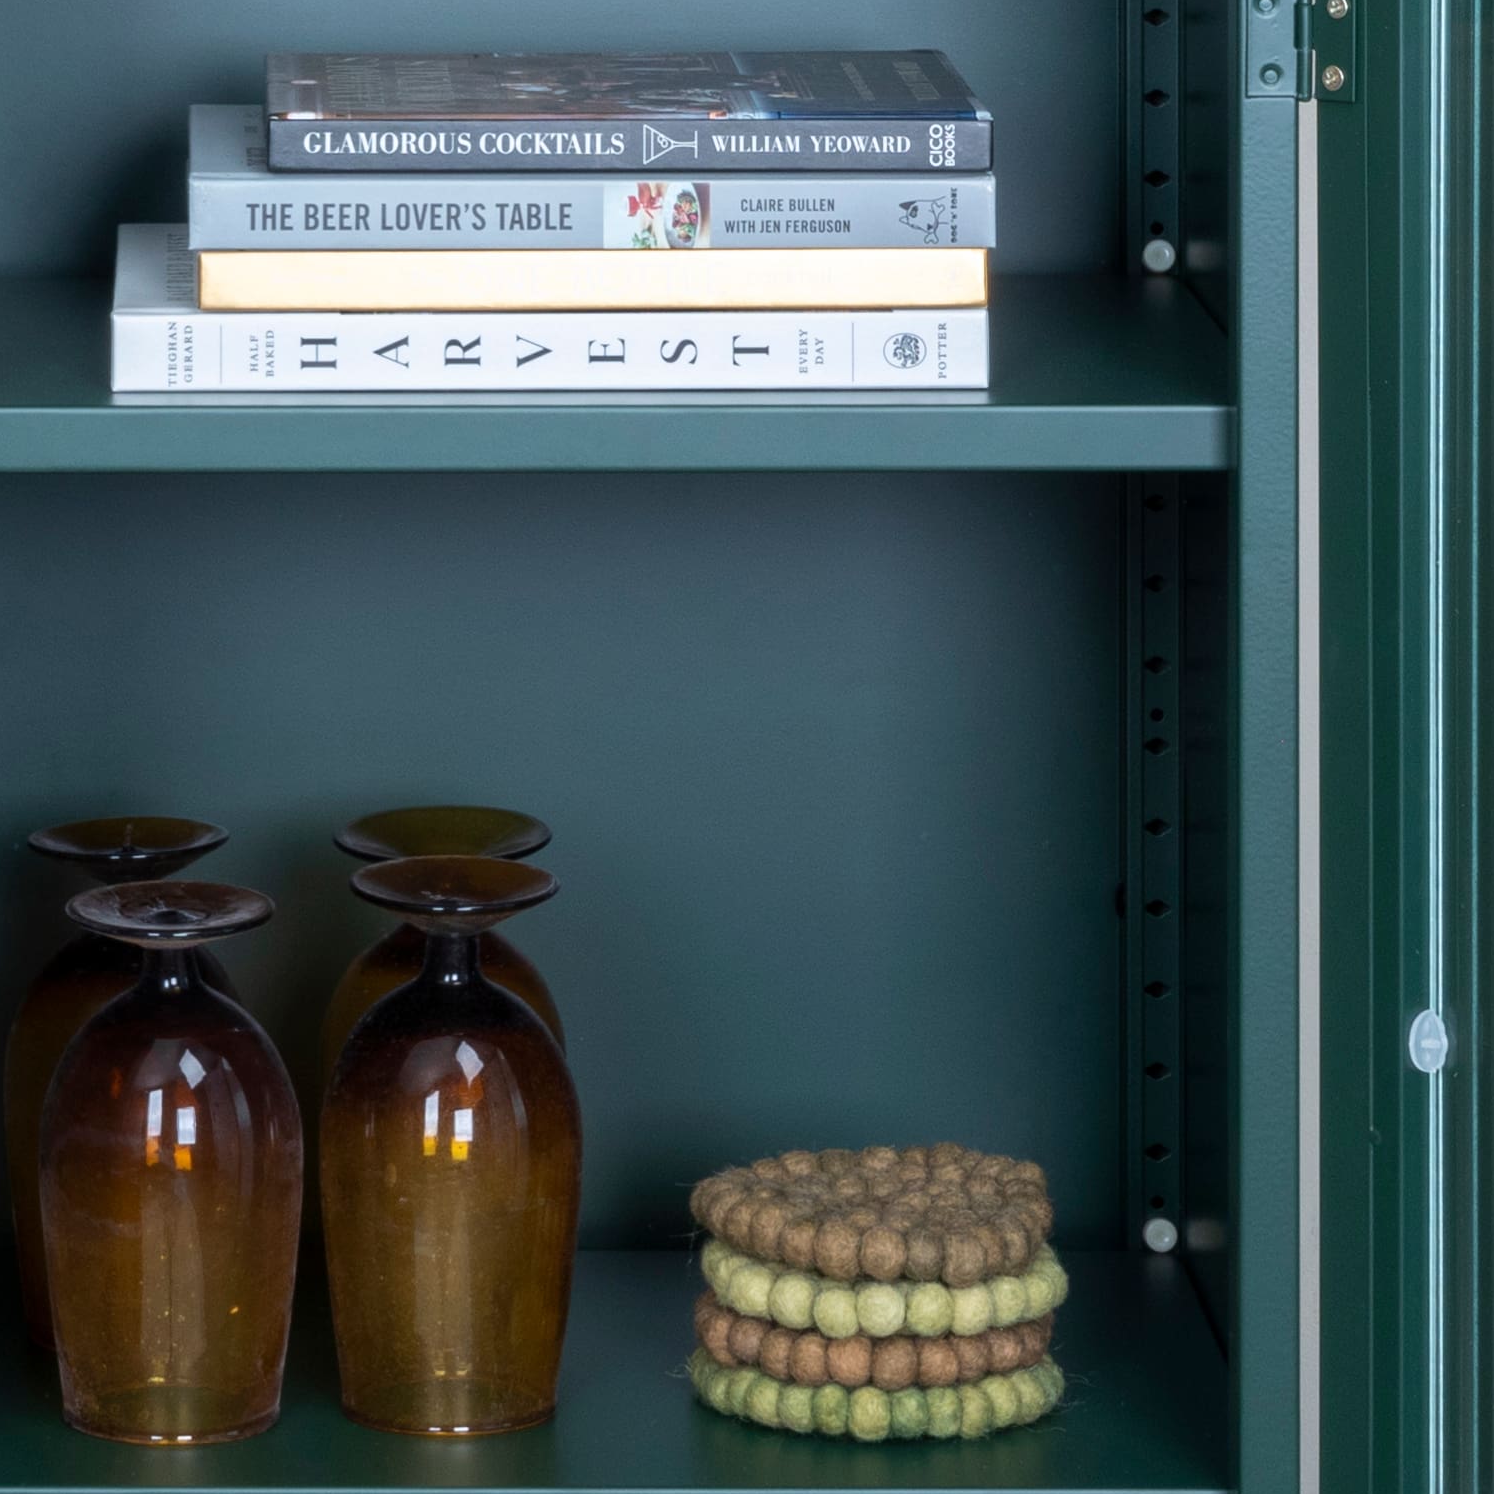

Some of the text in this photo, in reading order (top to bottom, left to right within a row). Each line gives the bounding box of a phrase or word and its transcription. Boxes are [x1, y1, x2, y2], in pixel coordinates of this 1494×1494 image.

[303, 131, 625, 155] GLAMOROUS COCKTAILS
[712, 135, 911, 153] WILLIAM YEOWARD
[929, 123, 943, 167] CICO
[945, 123, 956, 167] BOOKS
[246, 203, 573, 231] THE BEER LOVER’S TABLE
[740, 198, 835, 212] CLAIRE BULLEN
[724, 219, 851, 233] WITH JEN FERGUSON
[168, 321, 178, 387] TIEGHAN
[184, 325, 193, 383] GERARD
[250, 335, 259, 372] HALF
[266, 330, 275, 377] BAKED
[799, 328, 808, 374] EVERY
[815, 337, 825, 365] DAY
[938, 322, 947, 379] POTTER
